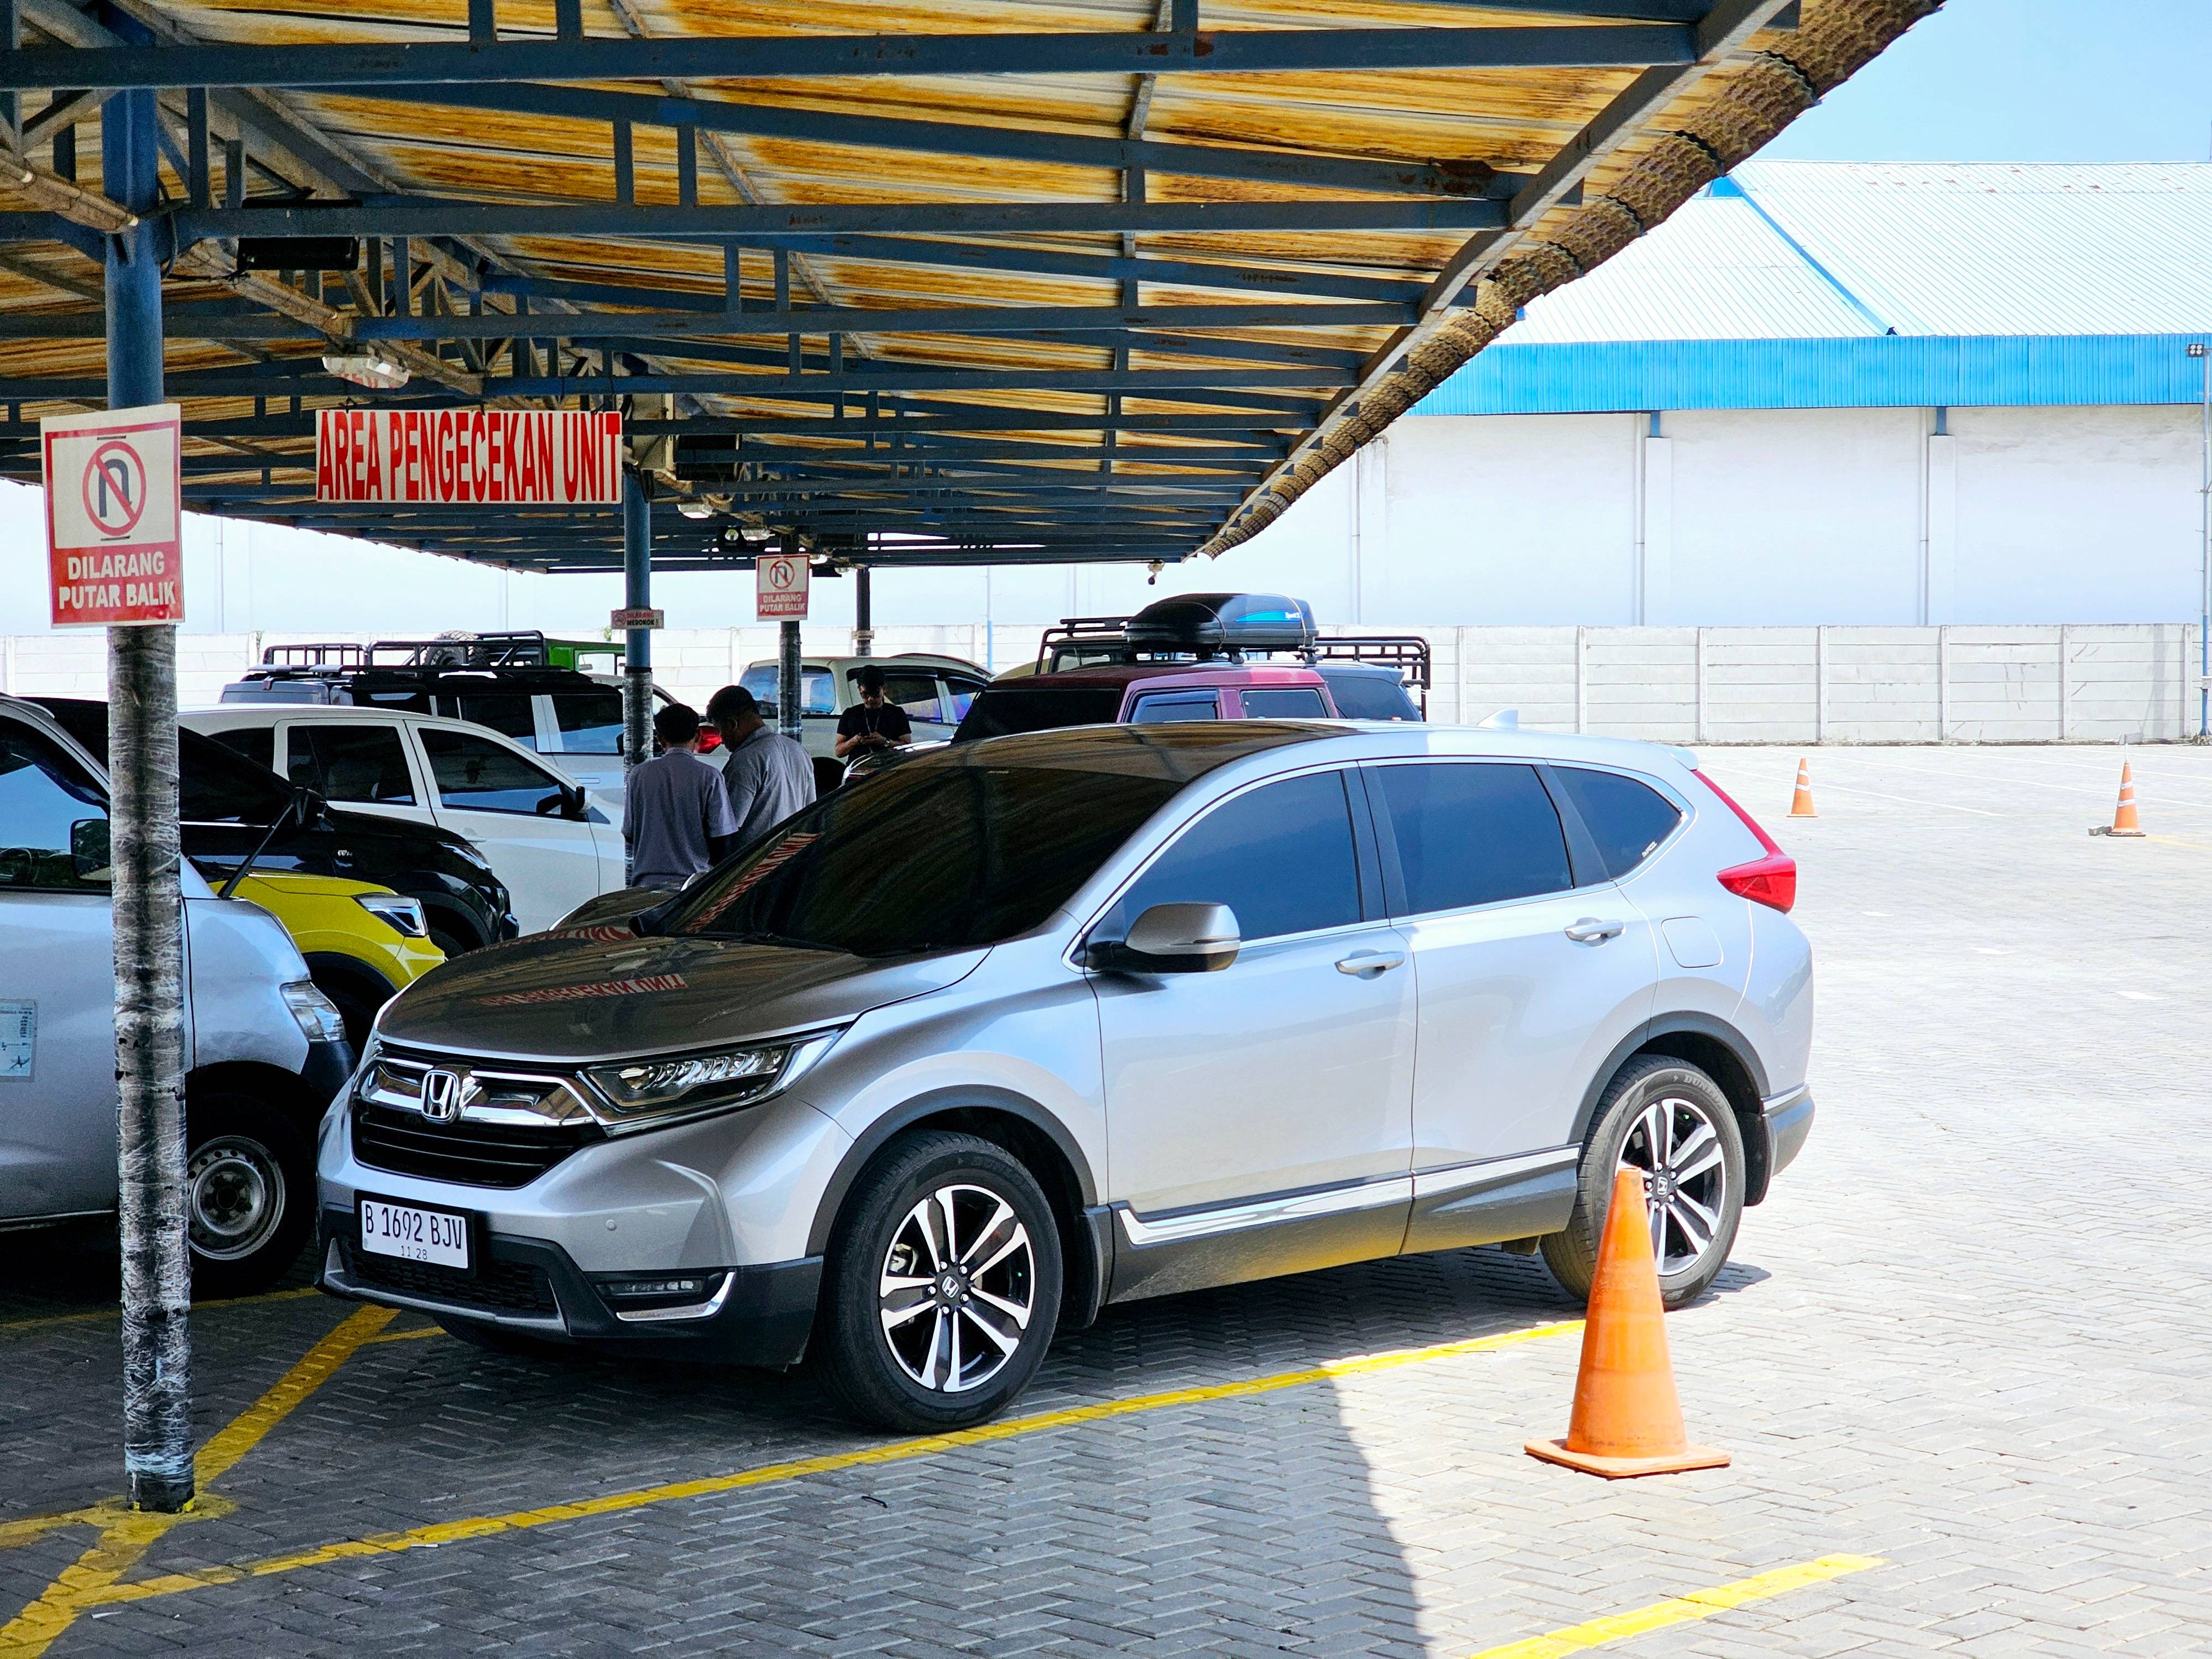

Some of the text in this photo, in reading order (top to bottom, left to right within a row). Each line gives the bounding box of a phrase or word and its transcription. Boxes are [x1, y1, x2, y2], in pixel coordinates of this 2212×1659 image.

[317, 411, 622, 503] AREA PENGECEKAN UNIT
[67, 551, 165, 580] DILARANG
[59, 581, 176, 609] PUTAR BALIK
[759, 604, 783, 612] PUTAR
[763, 594, 802, 603] DILARANG
[366, 1204, 462, 1249] B 1692 BJV
[401, 1245, 427, 1260] 11 28
